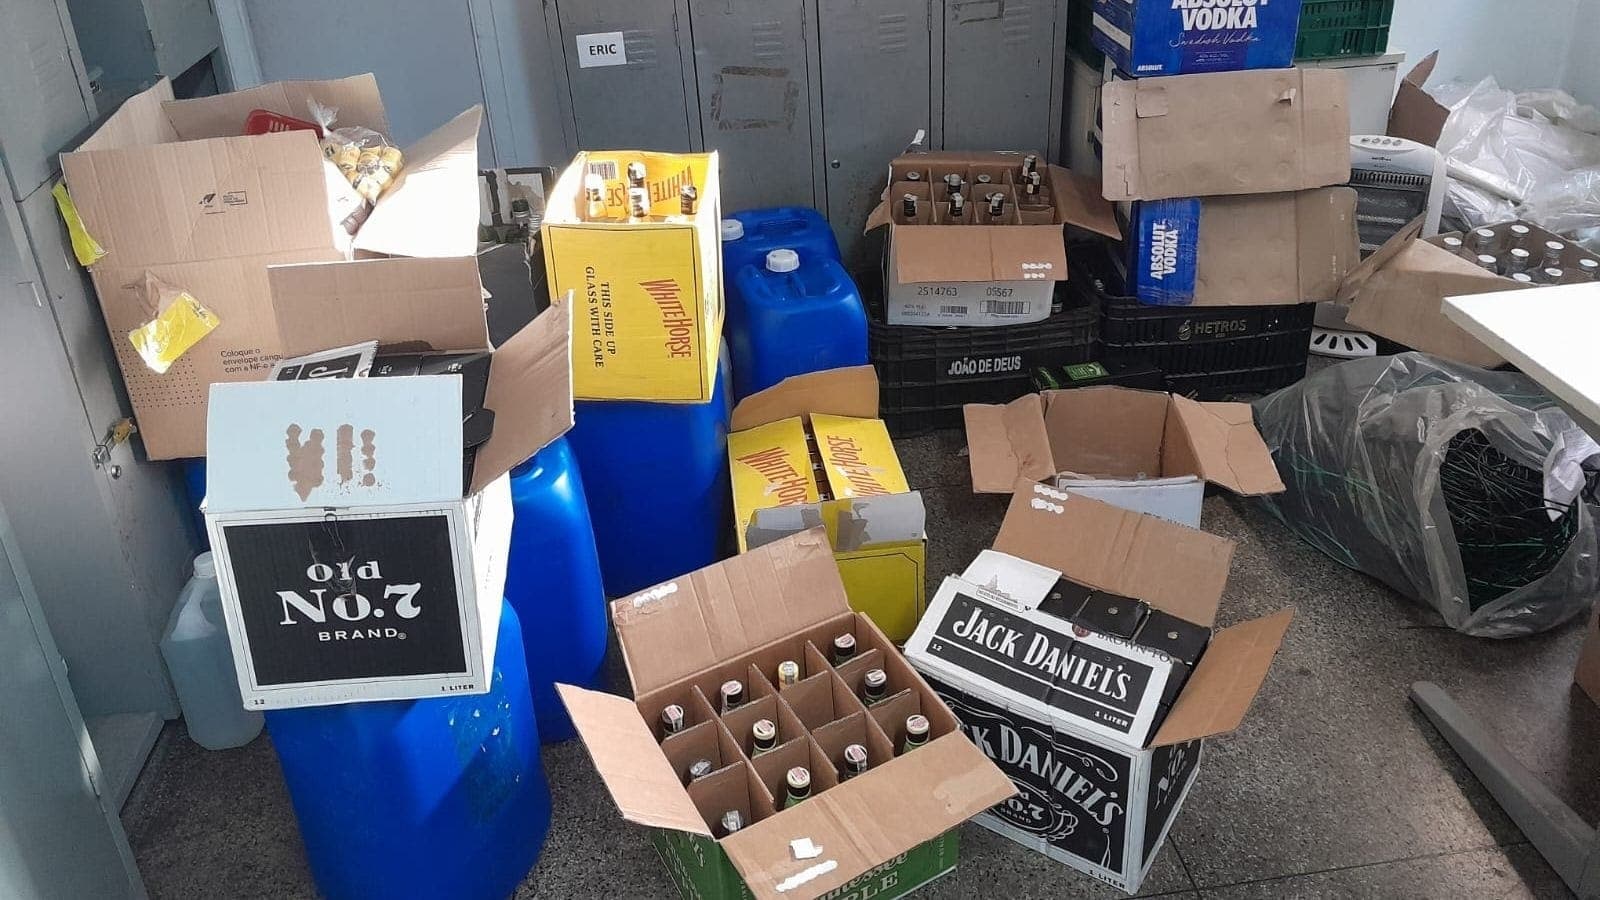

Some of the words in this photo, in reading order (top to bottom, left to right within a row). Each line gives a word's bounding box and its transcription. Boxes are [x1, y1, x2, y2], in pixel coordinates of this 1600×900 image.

[1181, 6, 1258, 31] VODKA
[589, 43, 617, 56] ERIC
[1150, 222, 1166, 280] ABSOLUT
[1163, 229, 1179, 274] VODKA
[585, 266, 598, 304] GLASS
[600, 282, 612, 308] THIS
[917, 286, 958, 297] 2514763
[590, 307, 601, 336] WITH
[603, 311, 615, 337] SIDE
[638, 278, 686, 318] WHITE
[663, 318, 694, 358] HORSE
[1194, 320, 1247, 335] HETROS
[220, 349, 254, 359] Coloque
[223, 357, 258, 366] envelope
[260, 353, 284, 361] cangu
[593, 339, 604, 368] CARE
[606, 340, 616, 355] UP
[948, 357, 977, 375] JOÃO
[978, 358, 993, 373] DE
[994, 355, 1021, 371] DEUS
[827, 435, 867, 468] HORSE
[736, 446, 799, 483] WHITE
[771, 477, 809, 506] HOR
[952, 606, 1024, 659] JACK
[1022, 632, 1131, 700] DANIEL'S
[931, 643, 943, 652] 12
[1103, 714, 1129, 728] LITER
[999, 723, 1124, 826] DANIEL'S
[1098, 873, 1126, 889] LITER
